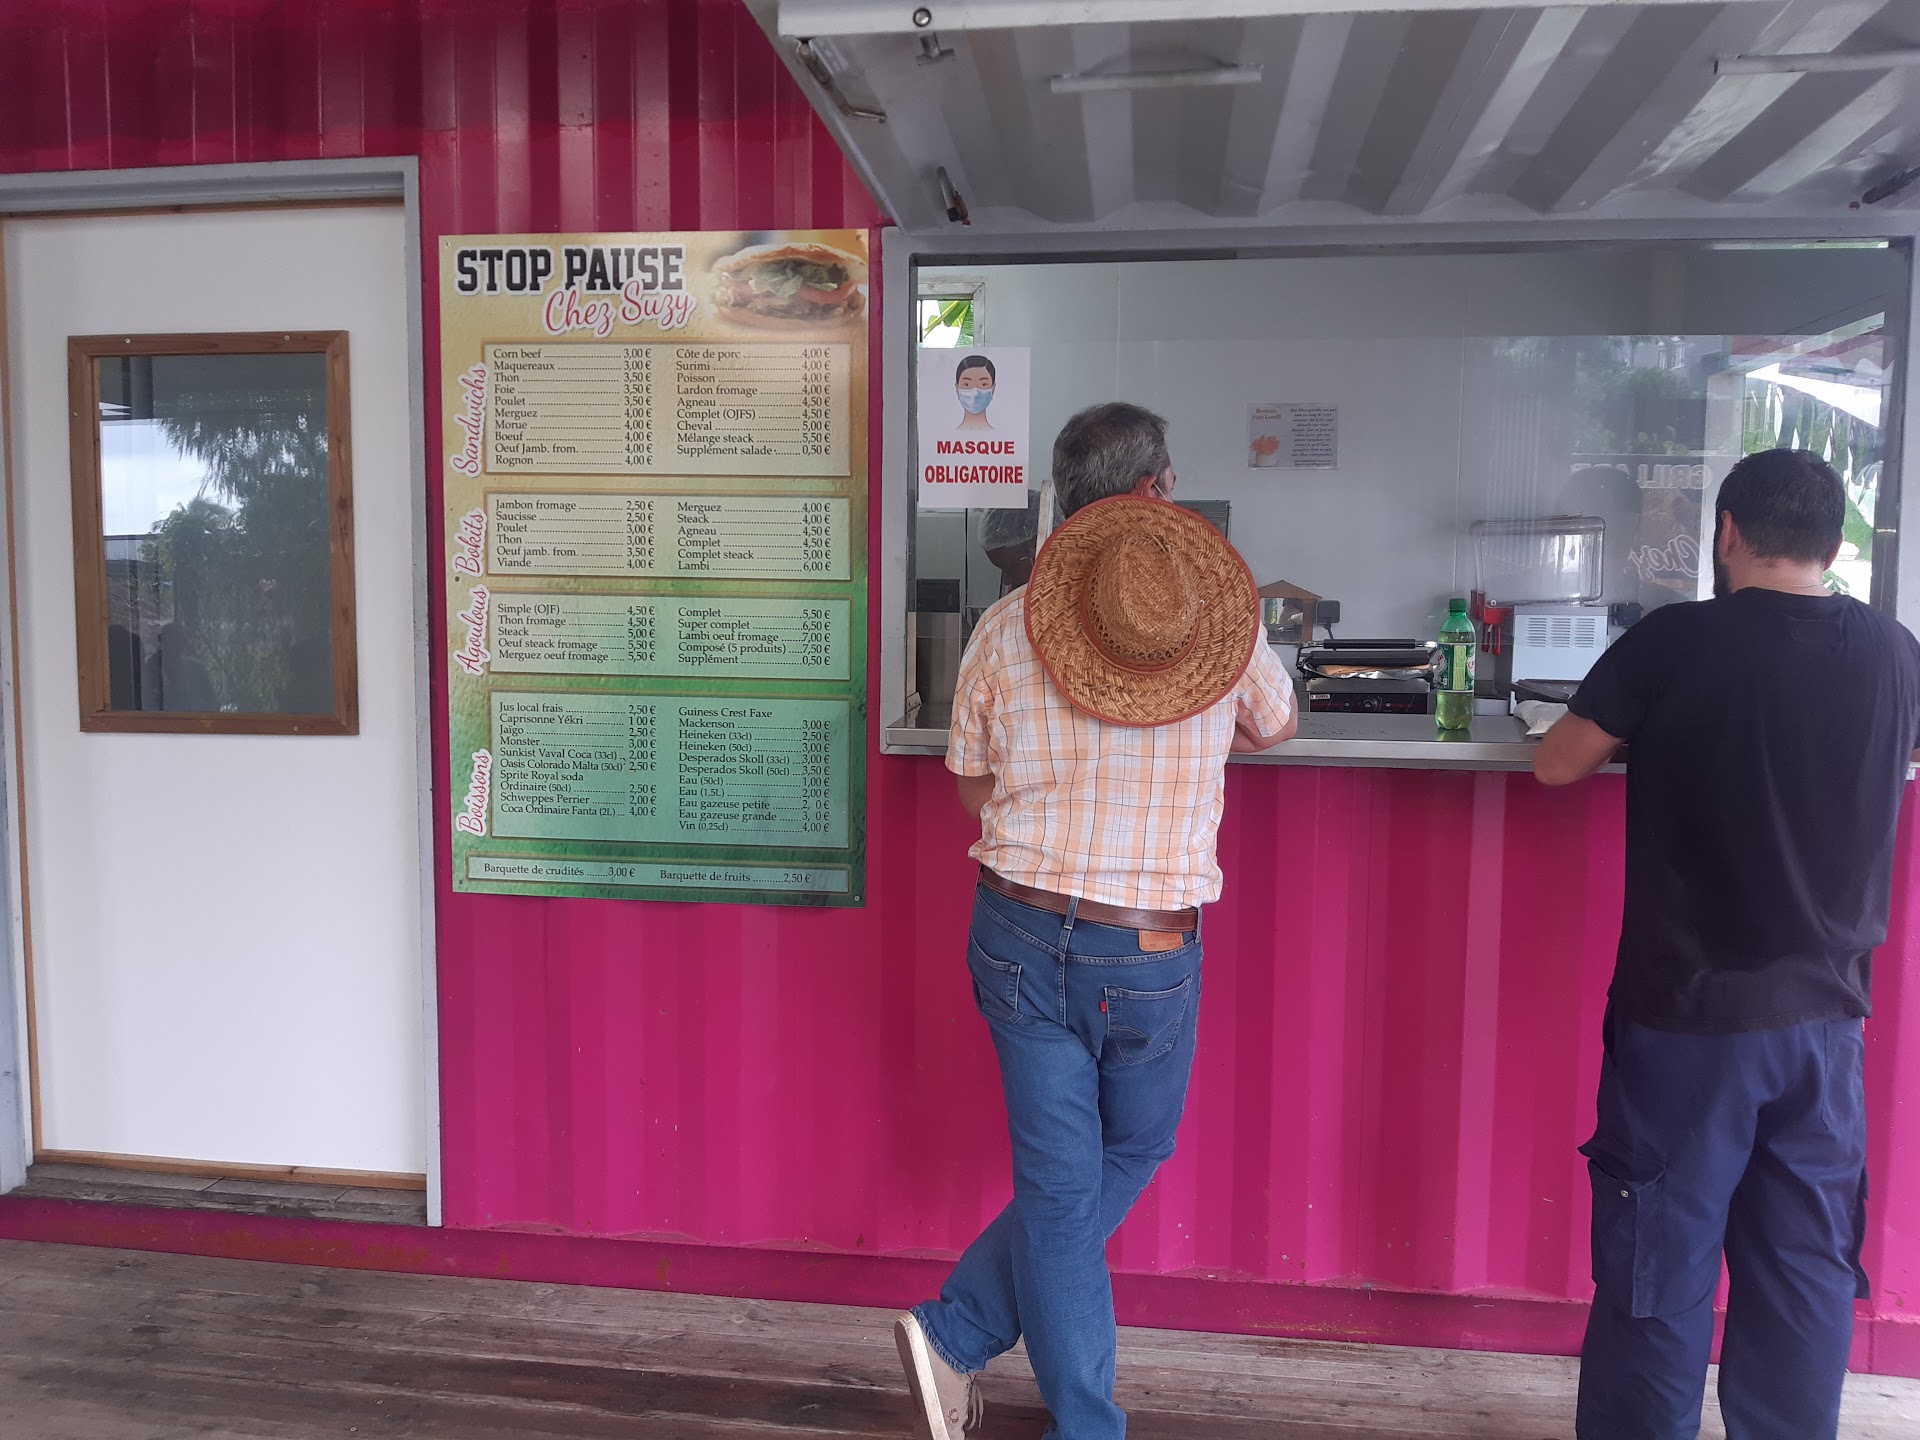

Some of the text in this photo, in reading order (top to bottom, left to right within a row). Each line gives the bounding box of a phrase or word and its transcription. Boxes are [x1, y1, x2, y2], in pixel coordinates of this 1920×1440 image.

[457, 247, 683, 291] STOP PAUSE
[545, 280, 692, 335] Chez Suzy
[493, 349, 519, 358] Corn
[521, 349, 542, 358] beef
[676, 349, 700, 358] Côte
[702, 349, 715, 358] de
[718, 351, 740, 361] porc
[494, 361, 555, 373] Maquereaux
[676, 360, 710, 370] Surimi
[494, 372, 519, 382] Thon
[677, 373, 715, 382] Poisson
[494, 384, 515, 394] Foie
[677, 385, 758, 397] Lardon fromage
[494, 396, 526, 406] Poulet
[677, 396, 716, 408] Agneau
[453, 366, 488, 474] Sandwichs
[494, 408, 538, 420] Merguez
[677, 409, 720, 421] Complet
[495, 419, 528, 429] Morue
[677, 420, 712, 430] Cheval
[495, 431, 524, 441] Boeuf
[677, 433, 754, 445] Mélange steack
[495, 443, 579, 455] Oeuf Jamb. from.
[740, 445, 772, 455] salade
[937, 441, 1015, 455] MASQUE
[496, 455, 534, 467] Rognon
[925, 465, 1023, 484] OBLIGATOIRE
[496, 500, 533, 511] Jambon
[536, 500, 576, 512] fromage
[677, 502, 722, 514] Merguez
[496, 511, 537, 521] Saucisse
[677, 514, 710, 523] Steack
[496, 523, 528, 532] Poulet
[678, 526, 717, 538] Agneau
[455, 512, 486, 574] Bokits
[497, 534, 522, 543] Thon
[678, 537, 721, 549] Complet
[497, 546, 579, 557] Oeuf jamb. from.
[678, 549, 754, 561] Complet steack
[498, 557, 531, 567] Viande
[678, 560, 710, 570] Lambi
[497, 604, 532, 616] Simple
[678, 607, 721, 619] Complet
[498, 615, 566, 627] Thon fromage
[678, 619, 750, 631] Super complet
[454, 588, 488, 672] Agoulous
[498, 626, 529, 635] Steack
[679, 630, 779, 643] Lambi oeuf fromage
[498, 638, 598, 650] Oeuf steack fromage
[678, 642, 725, 654] Composé
[740, 643, 786, 655] produits)
[499, 649, 608, 662] Merguez oeuf fromage
[499, 702, 514, 713] Jus
[517, 702, 539, 712] local
[542, 703, 563, 712] frais
[721, 707, 747, 717] Crest
[750, 707, 773, 717] Faxe
[500, 735, 540, 745] Monster
[679, 730, 726, 739] Heineken
[679, 741, 726, 751] Heineken
[499, 747, 537, 757] Sunkist
[539, 748, 565, 757] Vaval
[567, 748, 592, 758] Coca
[500, 758, 525, 768] Oasis
[528, 759, 570, 769] Colorado
[572, 760, 598, 769] Malta
[679, 753, 737, 765] Desperados
[739, 753, 764, 763] Skoll
[500, 769, 584, 782] Sprite Royal soda
[679, 764, 737, 776] Desperados
[739, 765, 764, 774] Skoll
[500, 780, 547, 790] Ordinaire
[679, 775, 698, 784] Eau
[459, 752, 491, 834] Boissons
[679, 786, 698, 796] Eau
[500, 792, 590, 804] Schweppes Perrier
[679, 797, 770, 811] Eau gazeuse petite
[501, 803, 523, 813] Coca
[525, 804, 569, 814] Ordinaire
[572, 805, 597, 815] Fanta
[679, 808, 777, 822] Eau gazeuse grande
[679, 820, 696, 829] Vin
[484, 863, 529, 875] Barquette
[531, 864, 543, 874] de
[546, 865, 584, 874] crudités
[660, 870, 750, 882] Barquette de fruits
